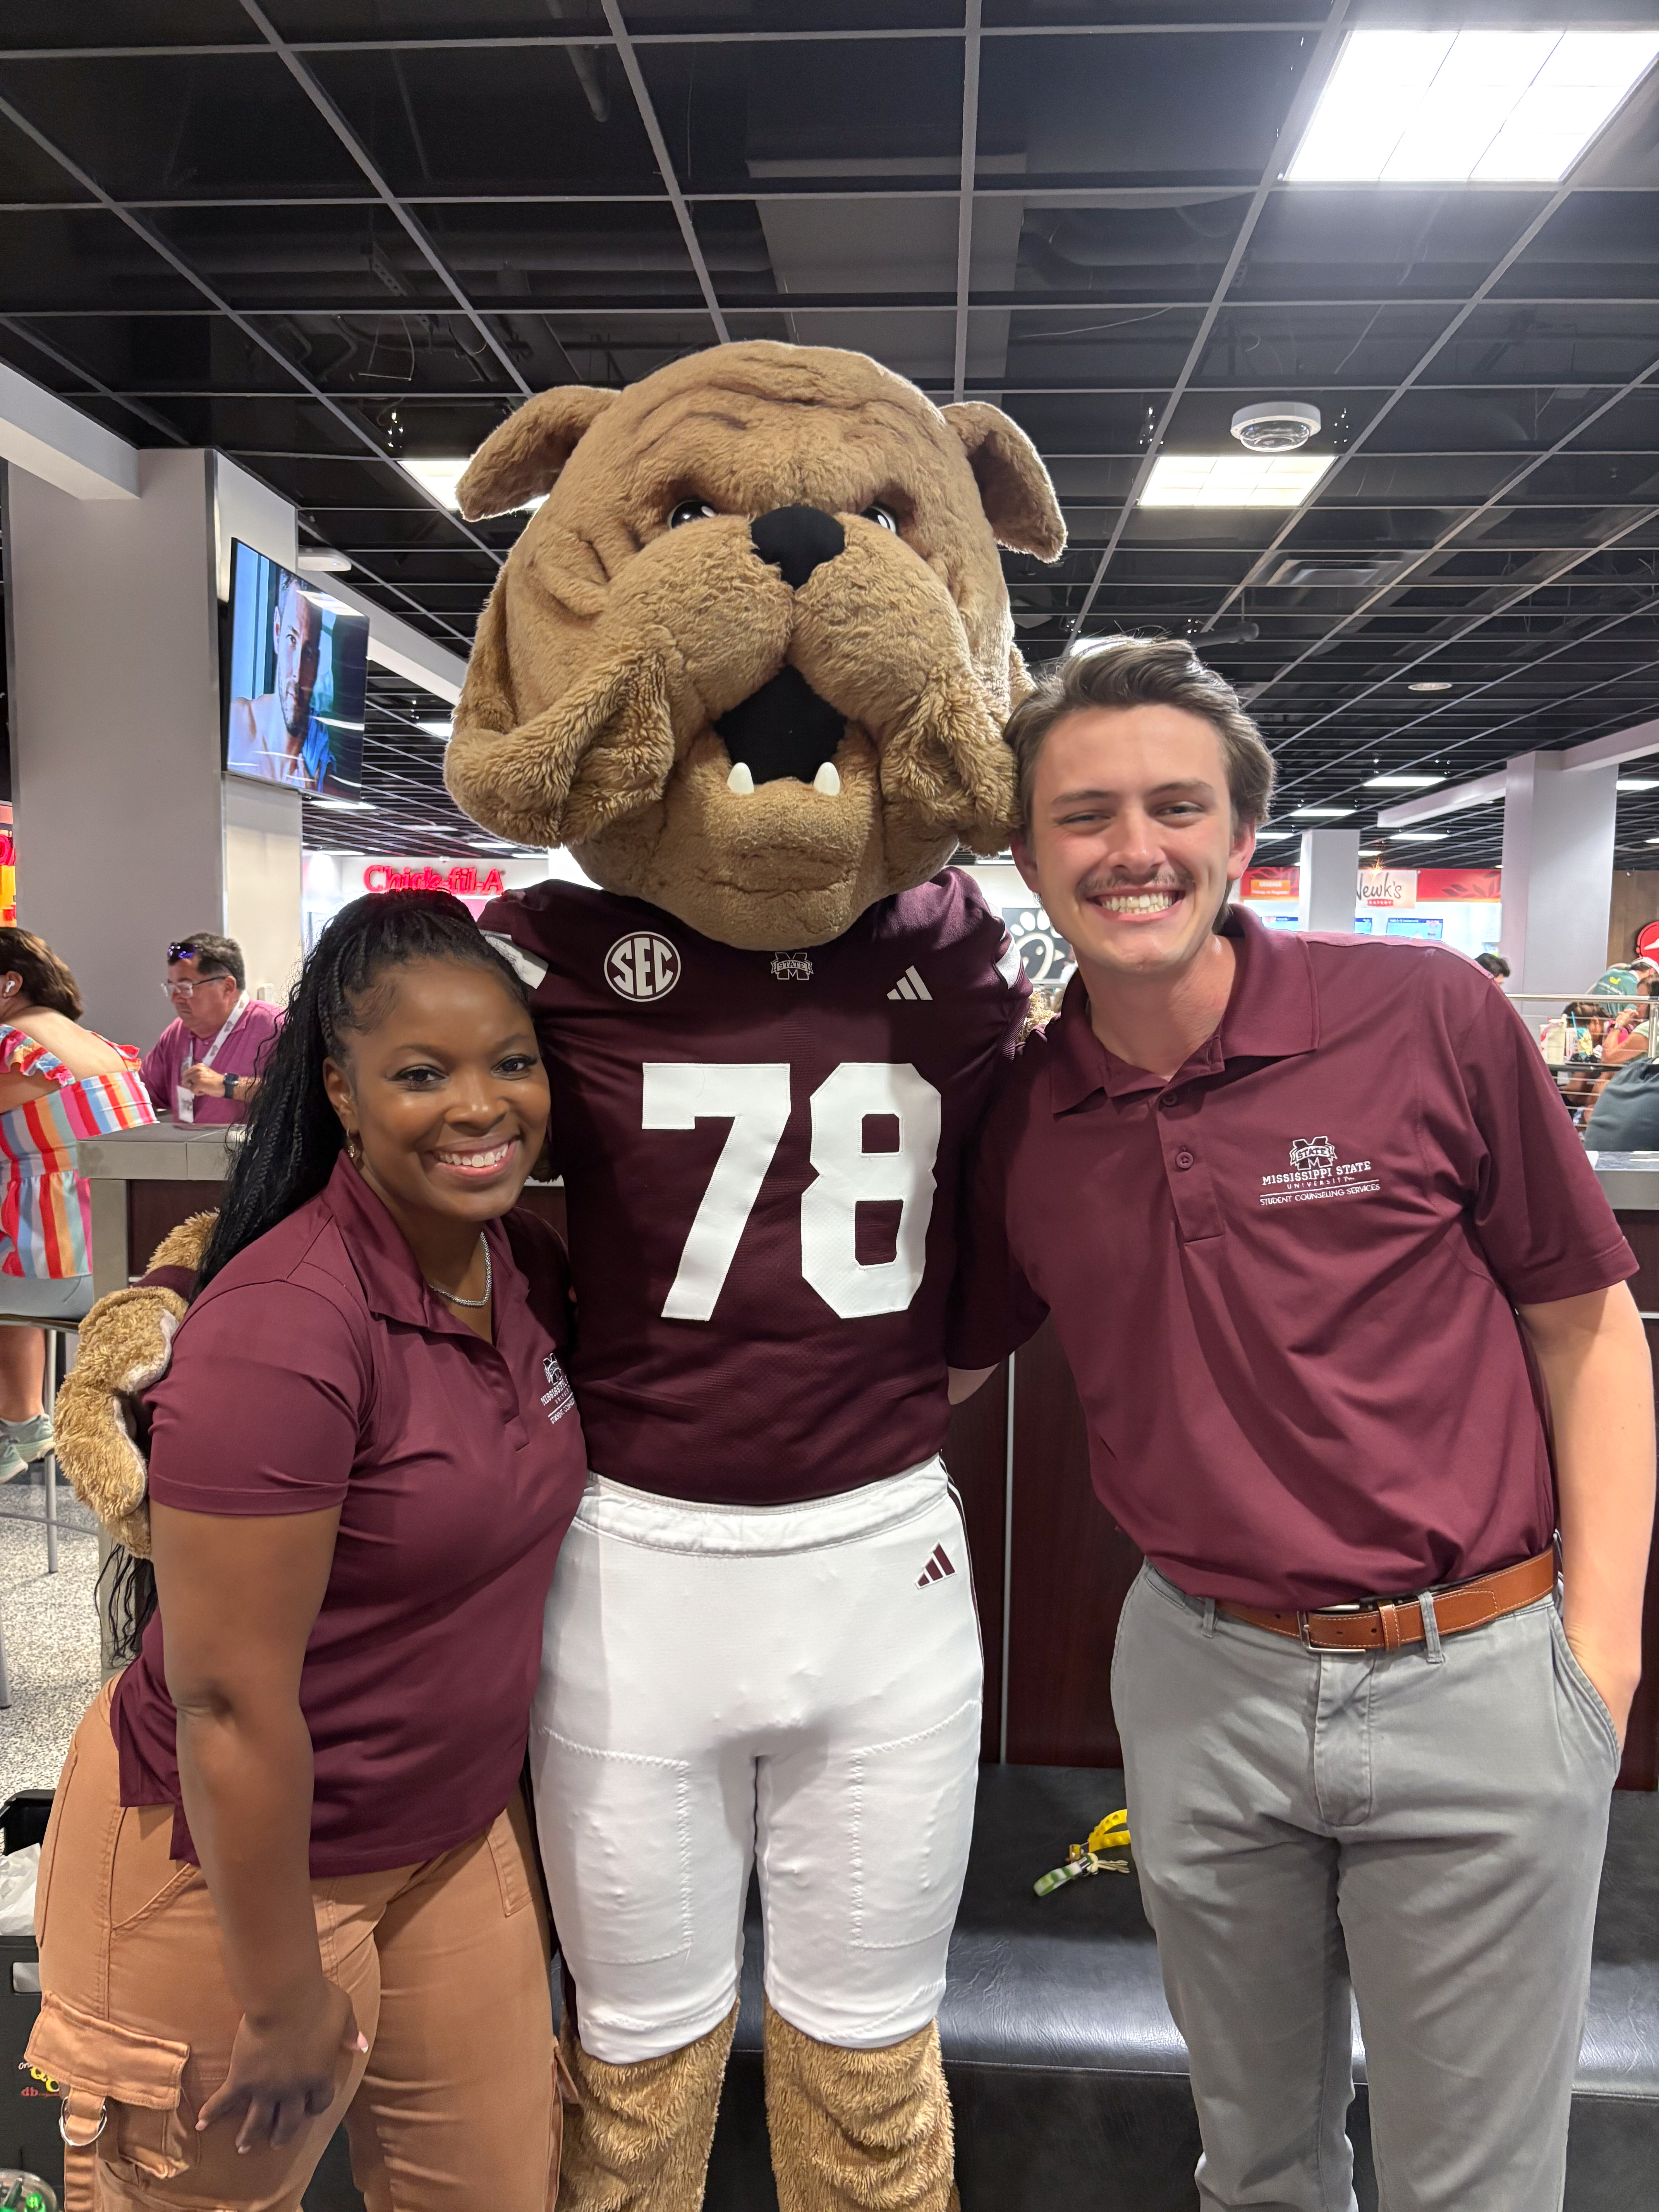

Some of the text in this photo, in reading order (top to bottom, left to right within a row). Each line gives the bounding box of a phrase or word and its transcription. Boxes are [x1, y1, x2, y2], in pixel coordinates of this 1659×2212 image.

[364, 865, 505, 895] Chick-fil-A
[611, 937, 674, 996] SEC
[779, 961, 805, 969] STATE
[1297, 1148, 1329, 1158] STATE
[1262, 1161, 1371, 1185] MISSISSIPPI STATE
[641, 1062, 941, 1321] 78
[1260, 1183, 1381, 1206] STUDENT COUNSELING SERVICES
